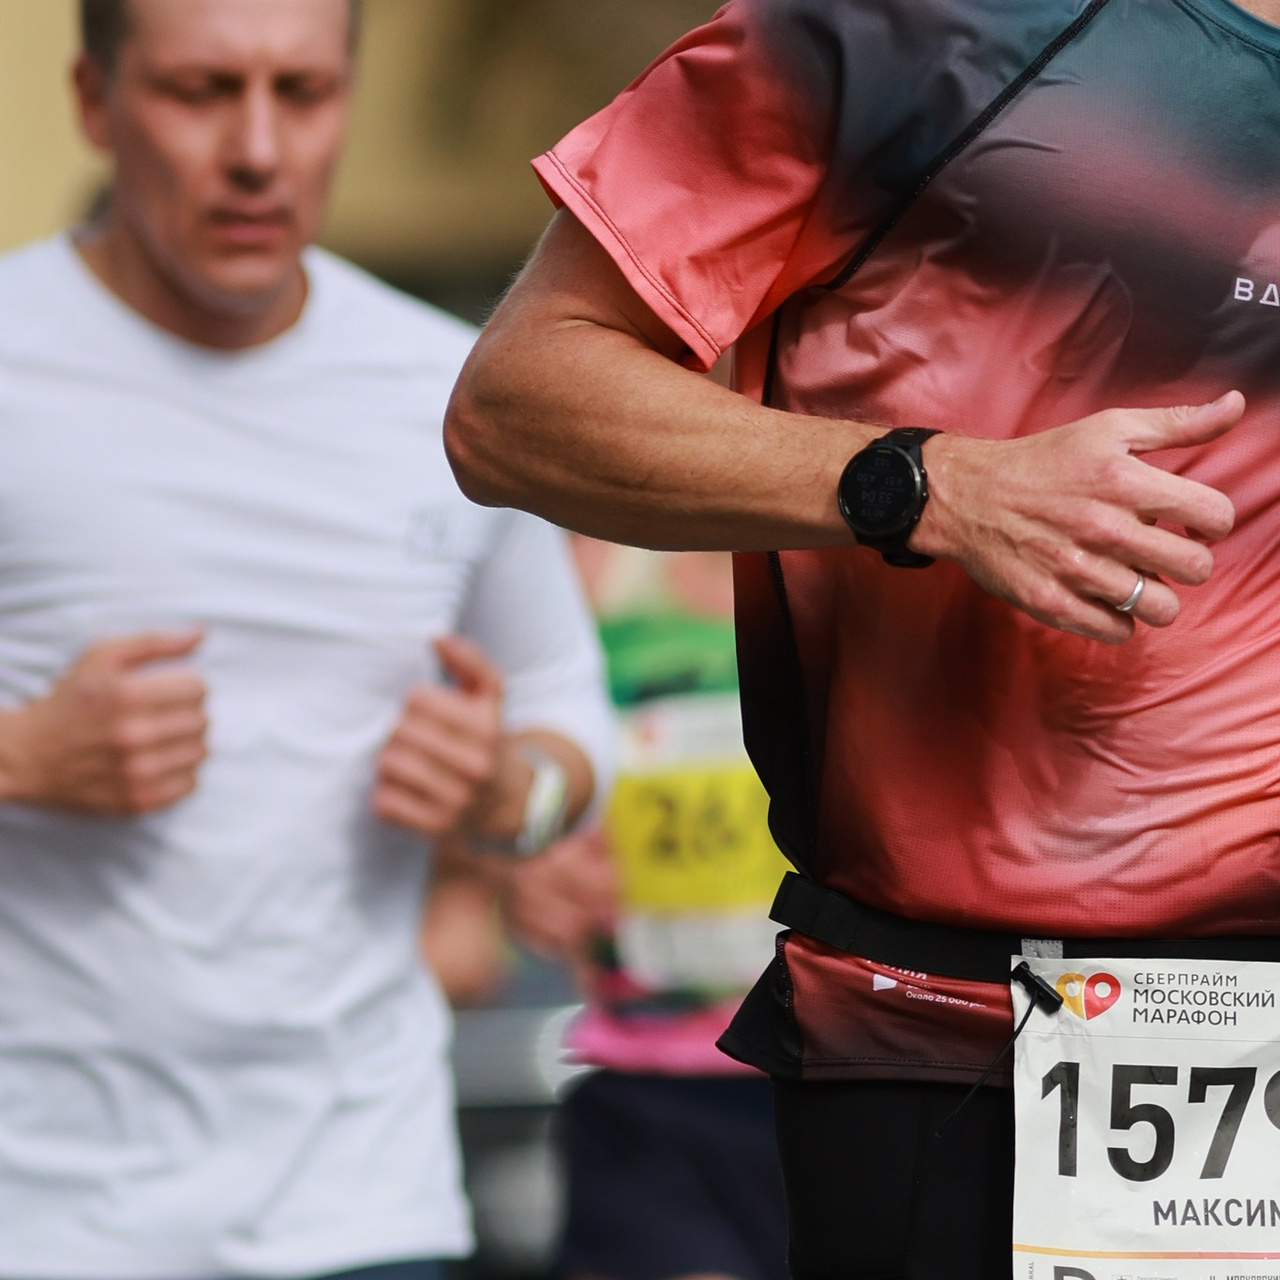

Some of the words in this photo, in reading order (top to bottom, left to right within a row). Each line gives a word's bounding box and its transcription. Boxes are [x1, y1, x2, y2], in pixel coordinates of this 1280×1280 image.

[1133, 972, 1238, 987] СБЕРПРАЙМ
[1133, 988, 1275, 1008] МОСКОВСКИЙ
[1132, 1007, 1238, 1026] МАРАФОН
